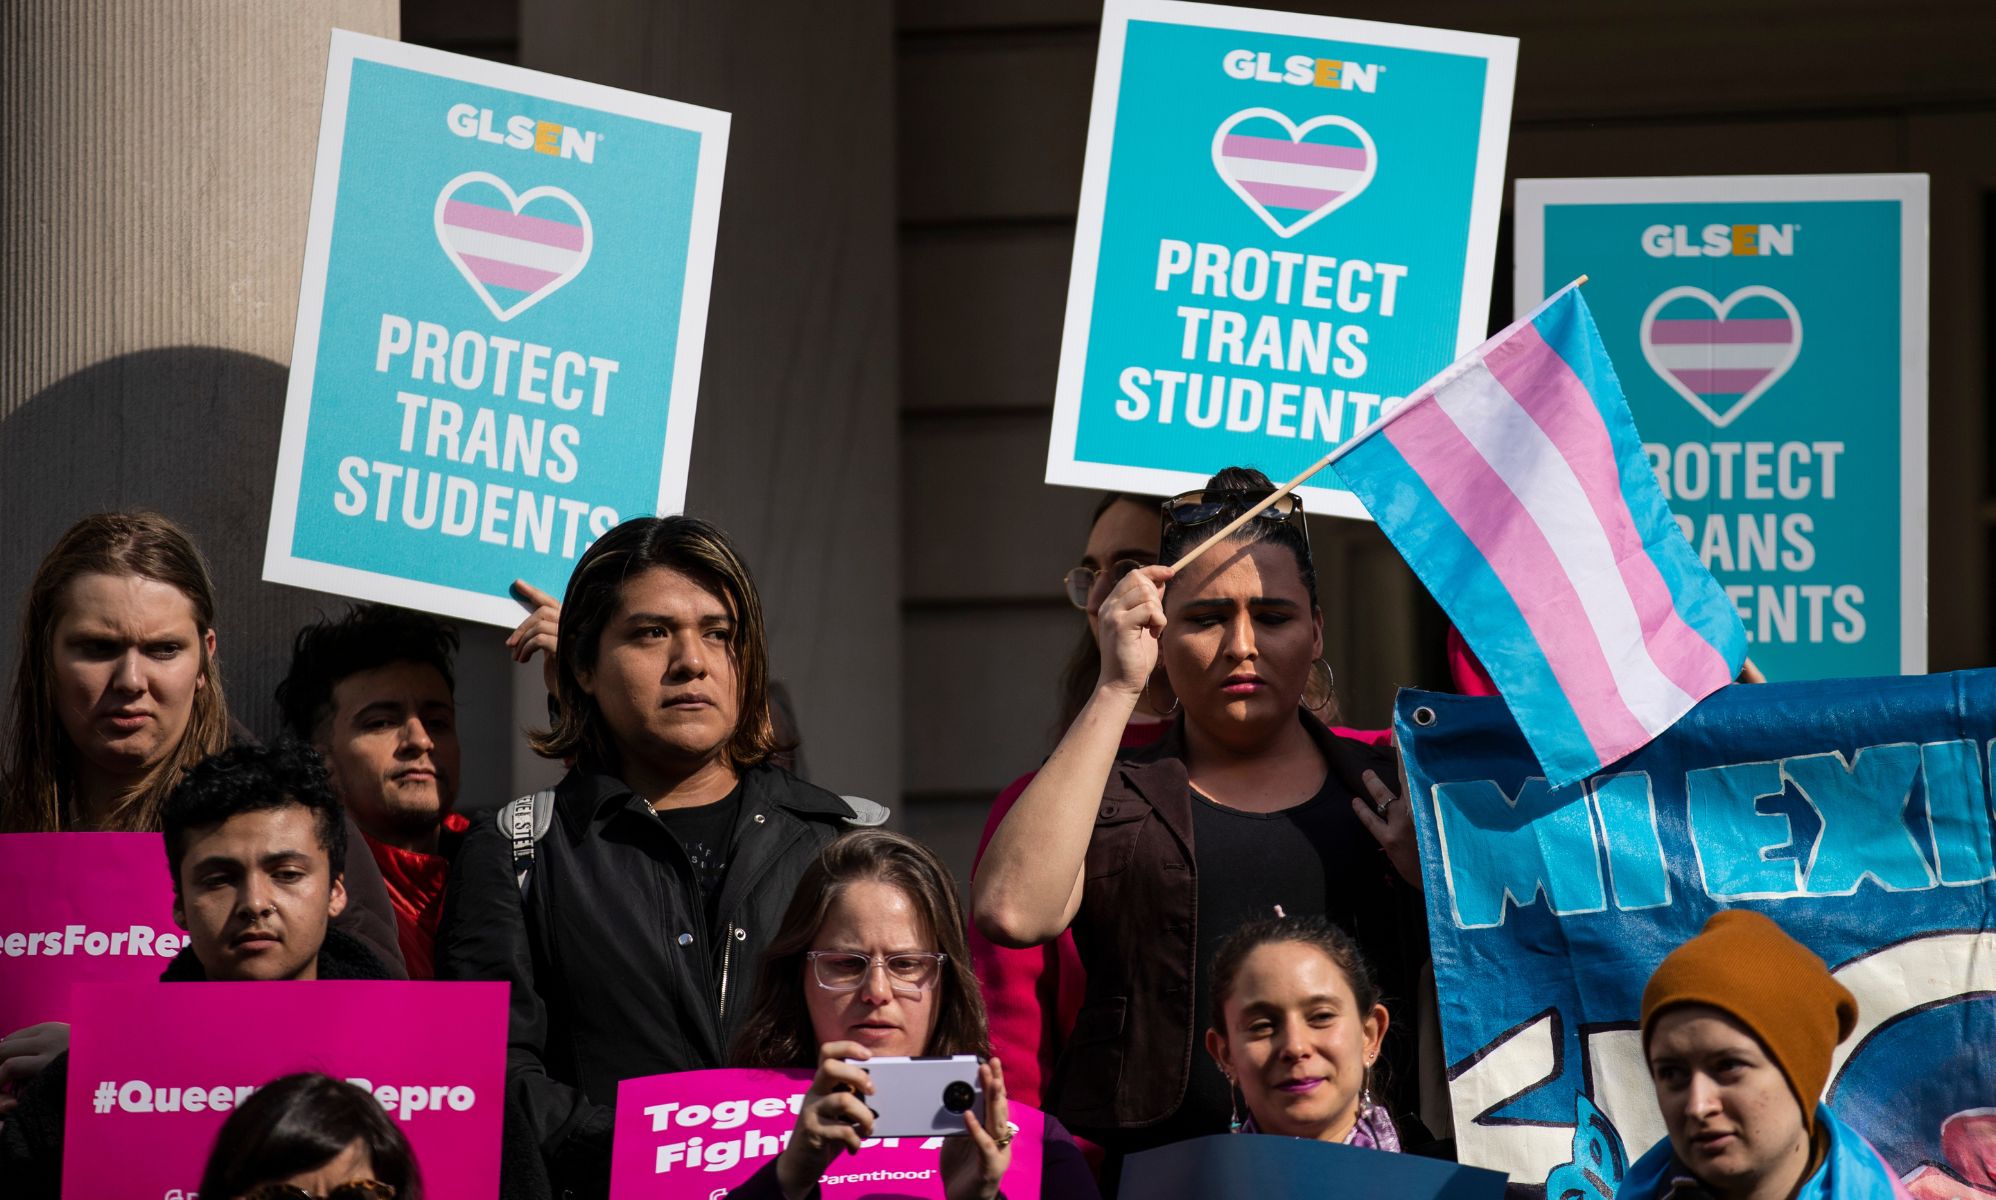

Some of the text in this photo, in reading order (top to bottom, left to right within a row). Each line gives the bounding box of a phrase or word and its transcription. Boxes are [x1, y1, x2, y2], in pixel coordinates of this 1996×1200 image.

[1223, 49, 1377, 93] GLSEN
[446, 103, 595, 164] GLSEN
[1641, 223, 1795, 258] GLSEN
[1155, 239, 1408, 317] PROTECT
[375, 313, 620, 416] PROTECT
[1177, 306, 1370, 379] TRANS
[396, 392, 581, 484] TRANS
[1641, 441, 1845, 500] ROTECT
[1679, 512, 1816, 571] ANS
[1725, 584, 1867, 644] ENTS
[1431, 737, 1996, 930] MI EXI
[0, 925, 191, 957] ersForRe
[93, 1078, 475, 1121] #Queerepro
[644, 1094, 806, 1132] Toget
